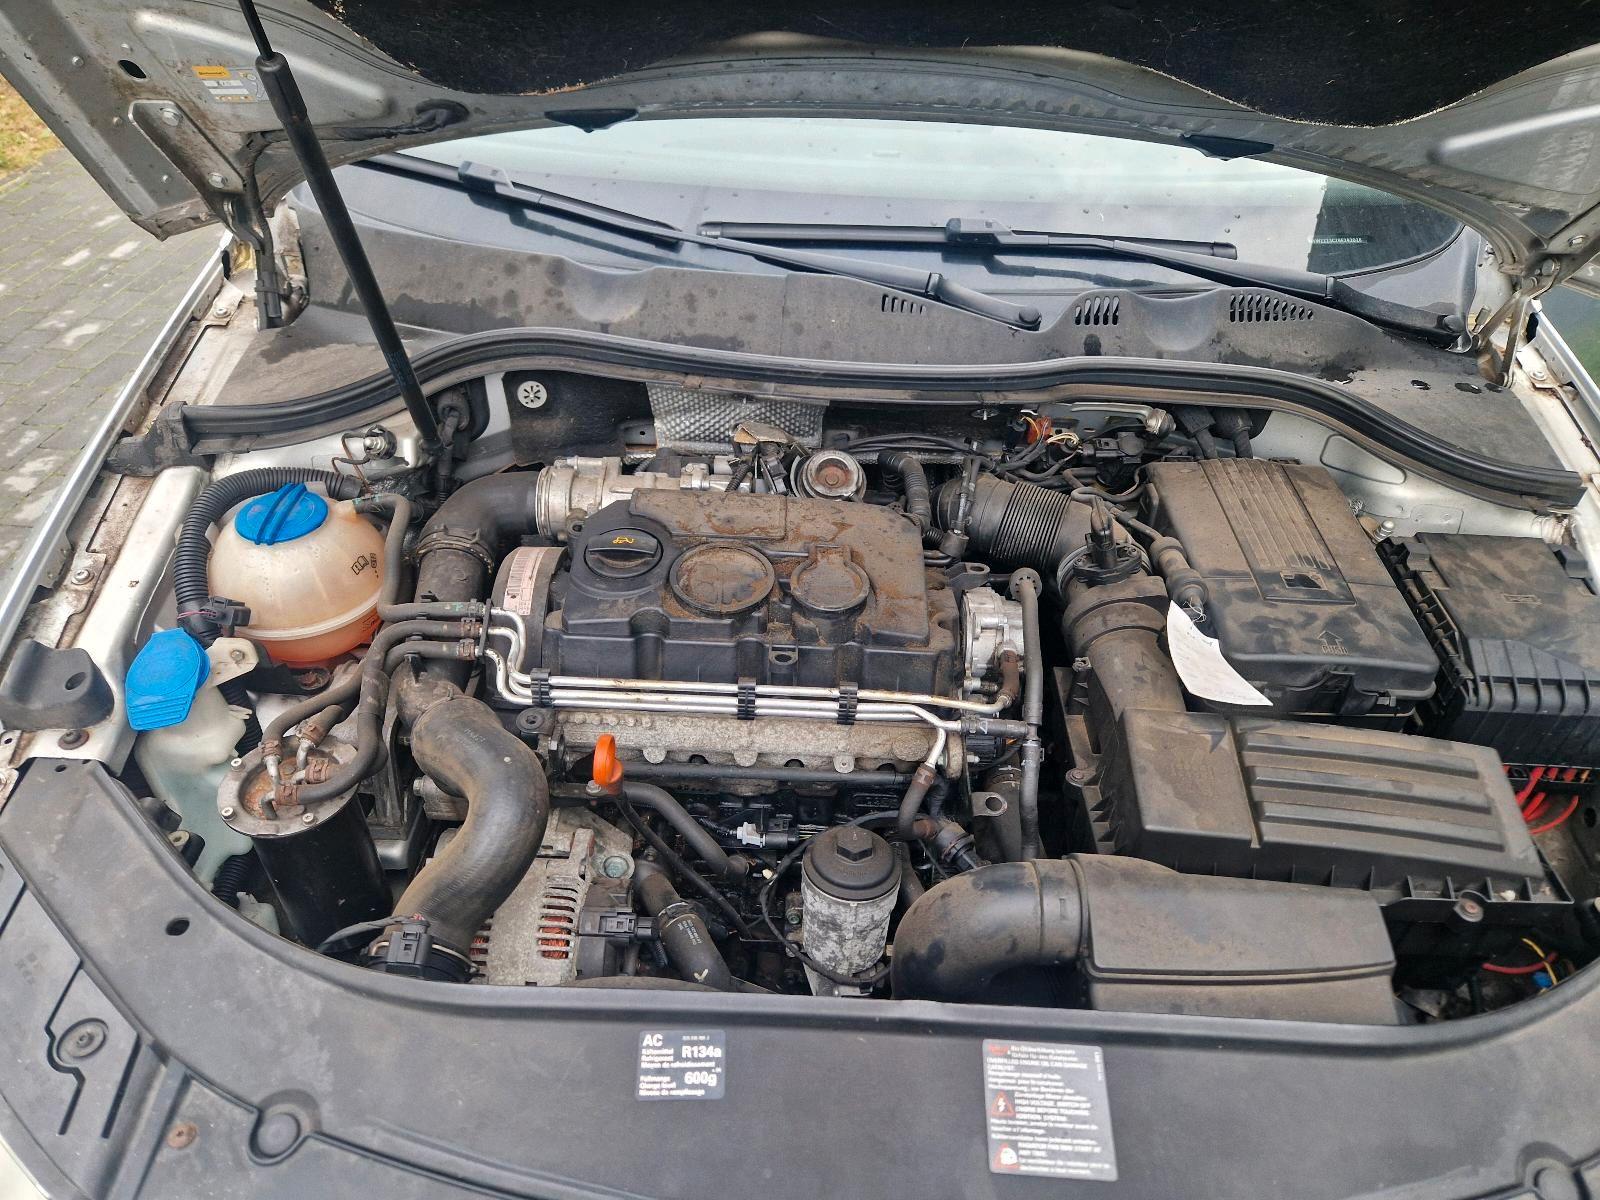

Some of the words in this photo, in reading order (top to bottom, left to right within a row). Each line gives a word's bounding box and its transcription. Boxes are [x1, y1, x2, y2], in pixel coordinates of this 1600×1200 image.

[642, 1033, 664, 1047] AC
[681, 1045, 722, 1059] R134a
[684, 1071, 718, 1087] 600g
